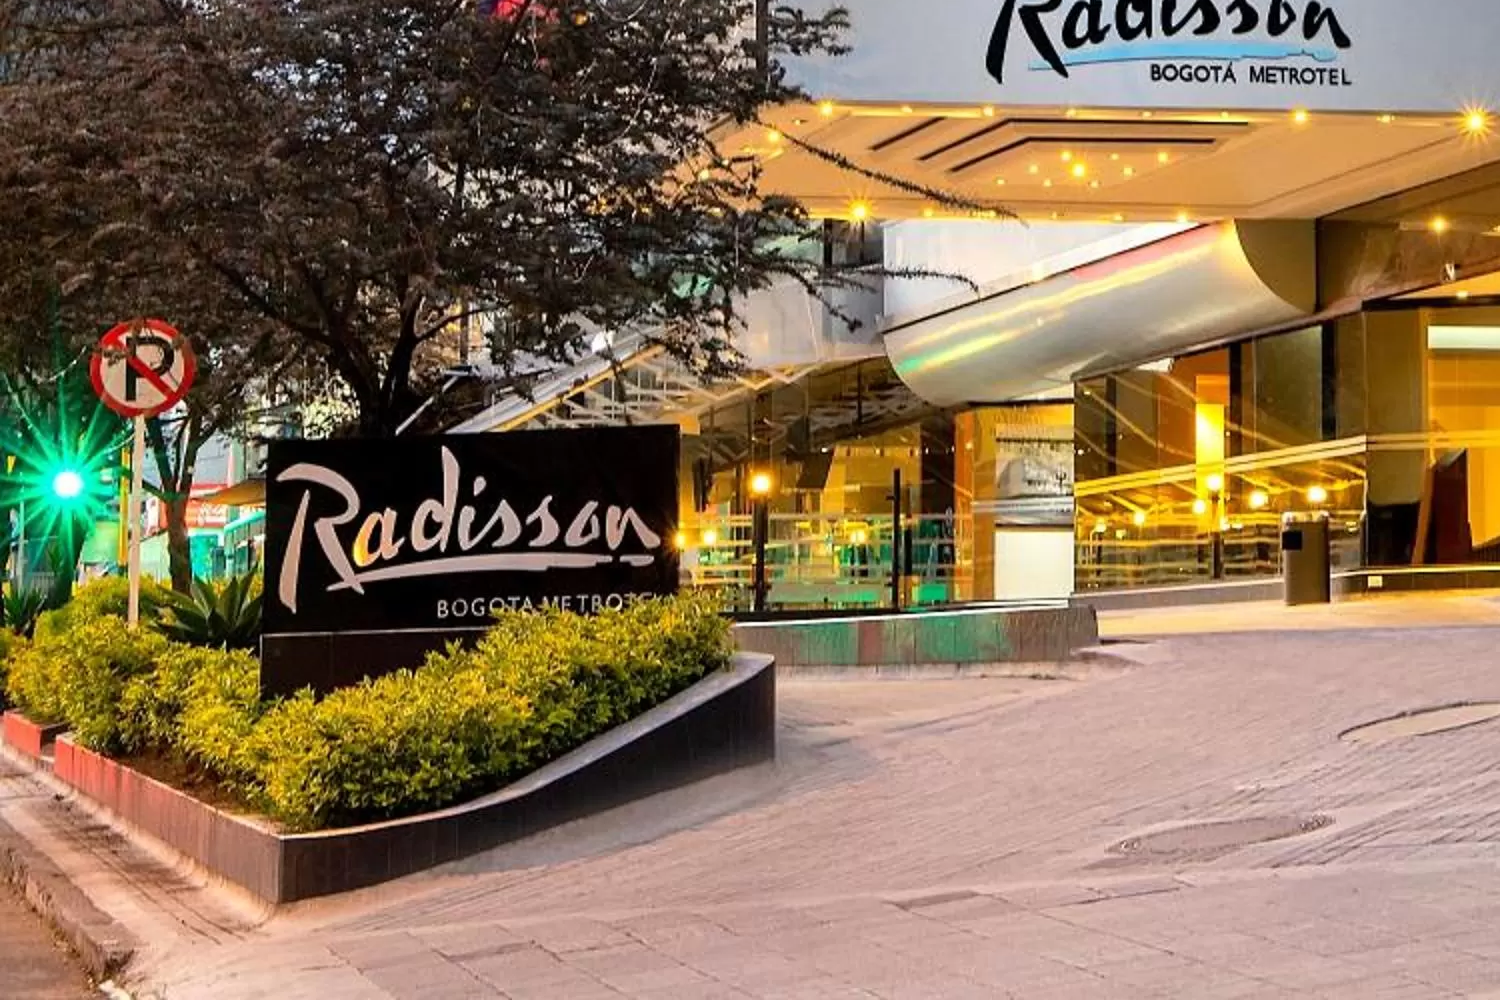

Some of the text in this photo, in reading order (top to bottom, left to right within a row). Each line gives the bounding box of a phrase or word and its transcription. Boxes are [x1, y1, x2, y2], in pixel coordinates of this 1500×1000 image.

[1150, 61, 1353, 87] BOGOTÁ METROTEL
[125, 336, 174, 402] P
[276, 444, 661, 614] Radisson
